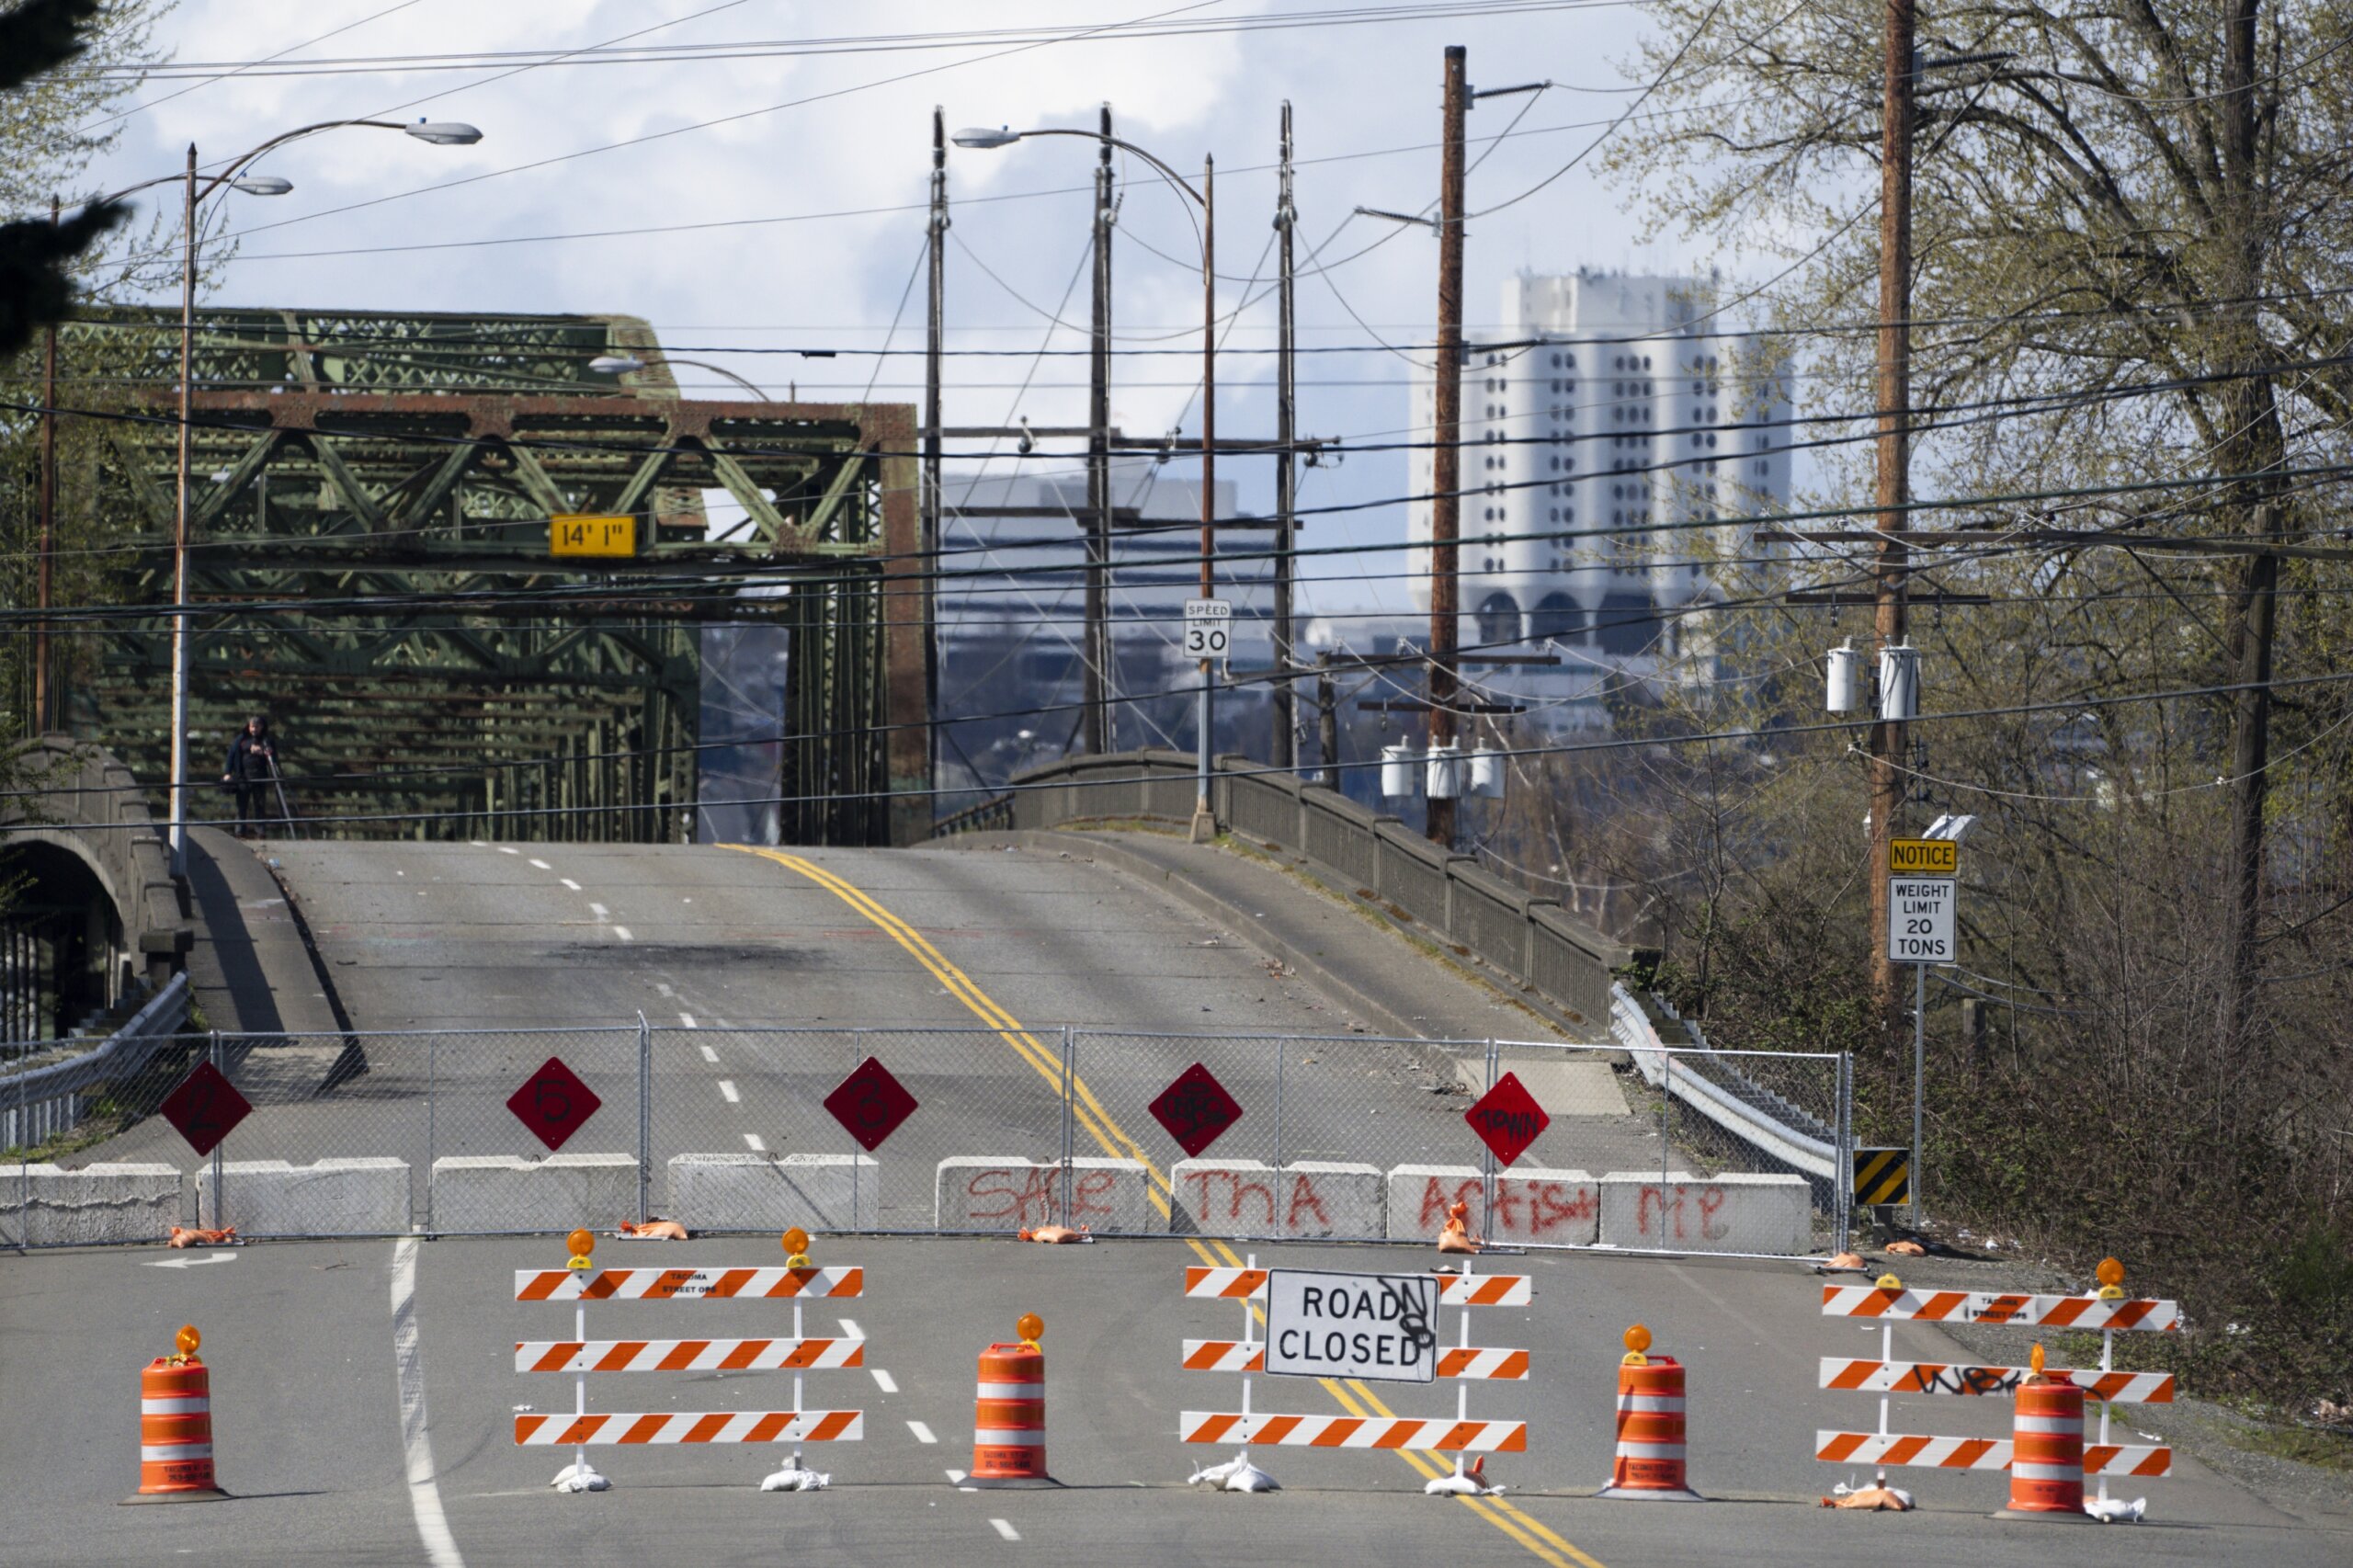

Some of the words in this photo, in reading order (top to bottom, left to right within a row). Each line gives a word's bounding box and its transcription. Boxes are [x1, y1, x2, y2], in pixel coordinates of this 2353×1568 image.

[562, 523, 593, 547] 14'
[603, 524, 623, 547] 1"
[1188, 606, 1229, 616] SPEED
[1192, 618, 1221, 627] LIMIT
[1188, 630, 1227, 652] 30
[1893, 846, 1953, 865] NOTICE
[1895, 884, 1949, 898] WEIGHT
[1904, 901, 1941, 915] LIMIT
[1906, 919, 1933, 935] 20
[1898, 938, 1946, 956] TONS
[187, 1081, 222, 1134] 2
[535, 1078, 573, 1123] 5
[847, 1077, 889, 1130] 3
[1476, 1108, 1540, 1142] TOWN
[1302, 1286, 1401, 1322] ROAD
[1279, 1329, 1422, 1367] CLOSED
